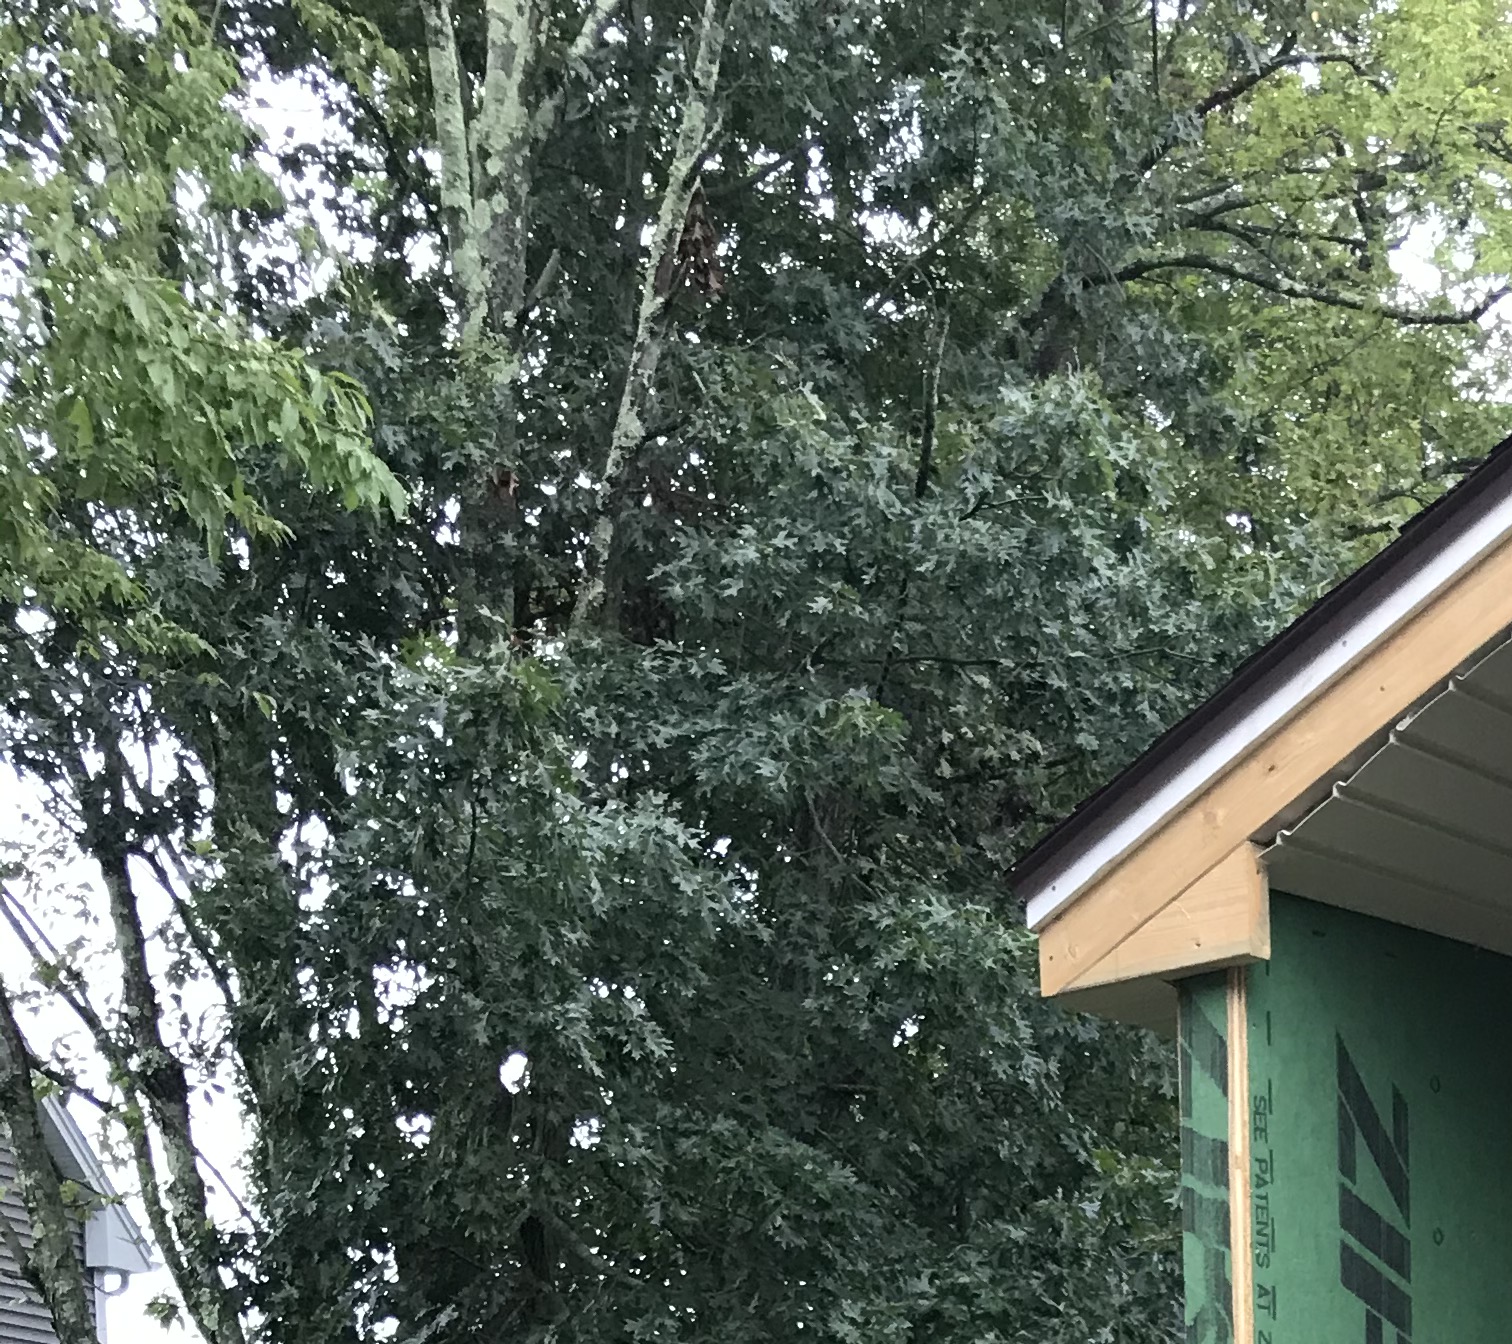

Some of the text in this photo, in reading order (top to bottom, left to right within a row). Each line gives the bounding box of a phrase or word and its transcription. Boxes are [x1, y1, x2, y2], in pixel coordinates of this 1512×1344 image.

[1252, 1094, 1269, 1143] SEE
[1254, 1156, 1273, 1269] PATENTS
[1257, 1283, 1276, 1320] AT
